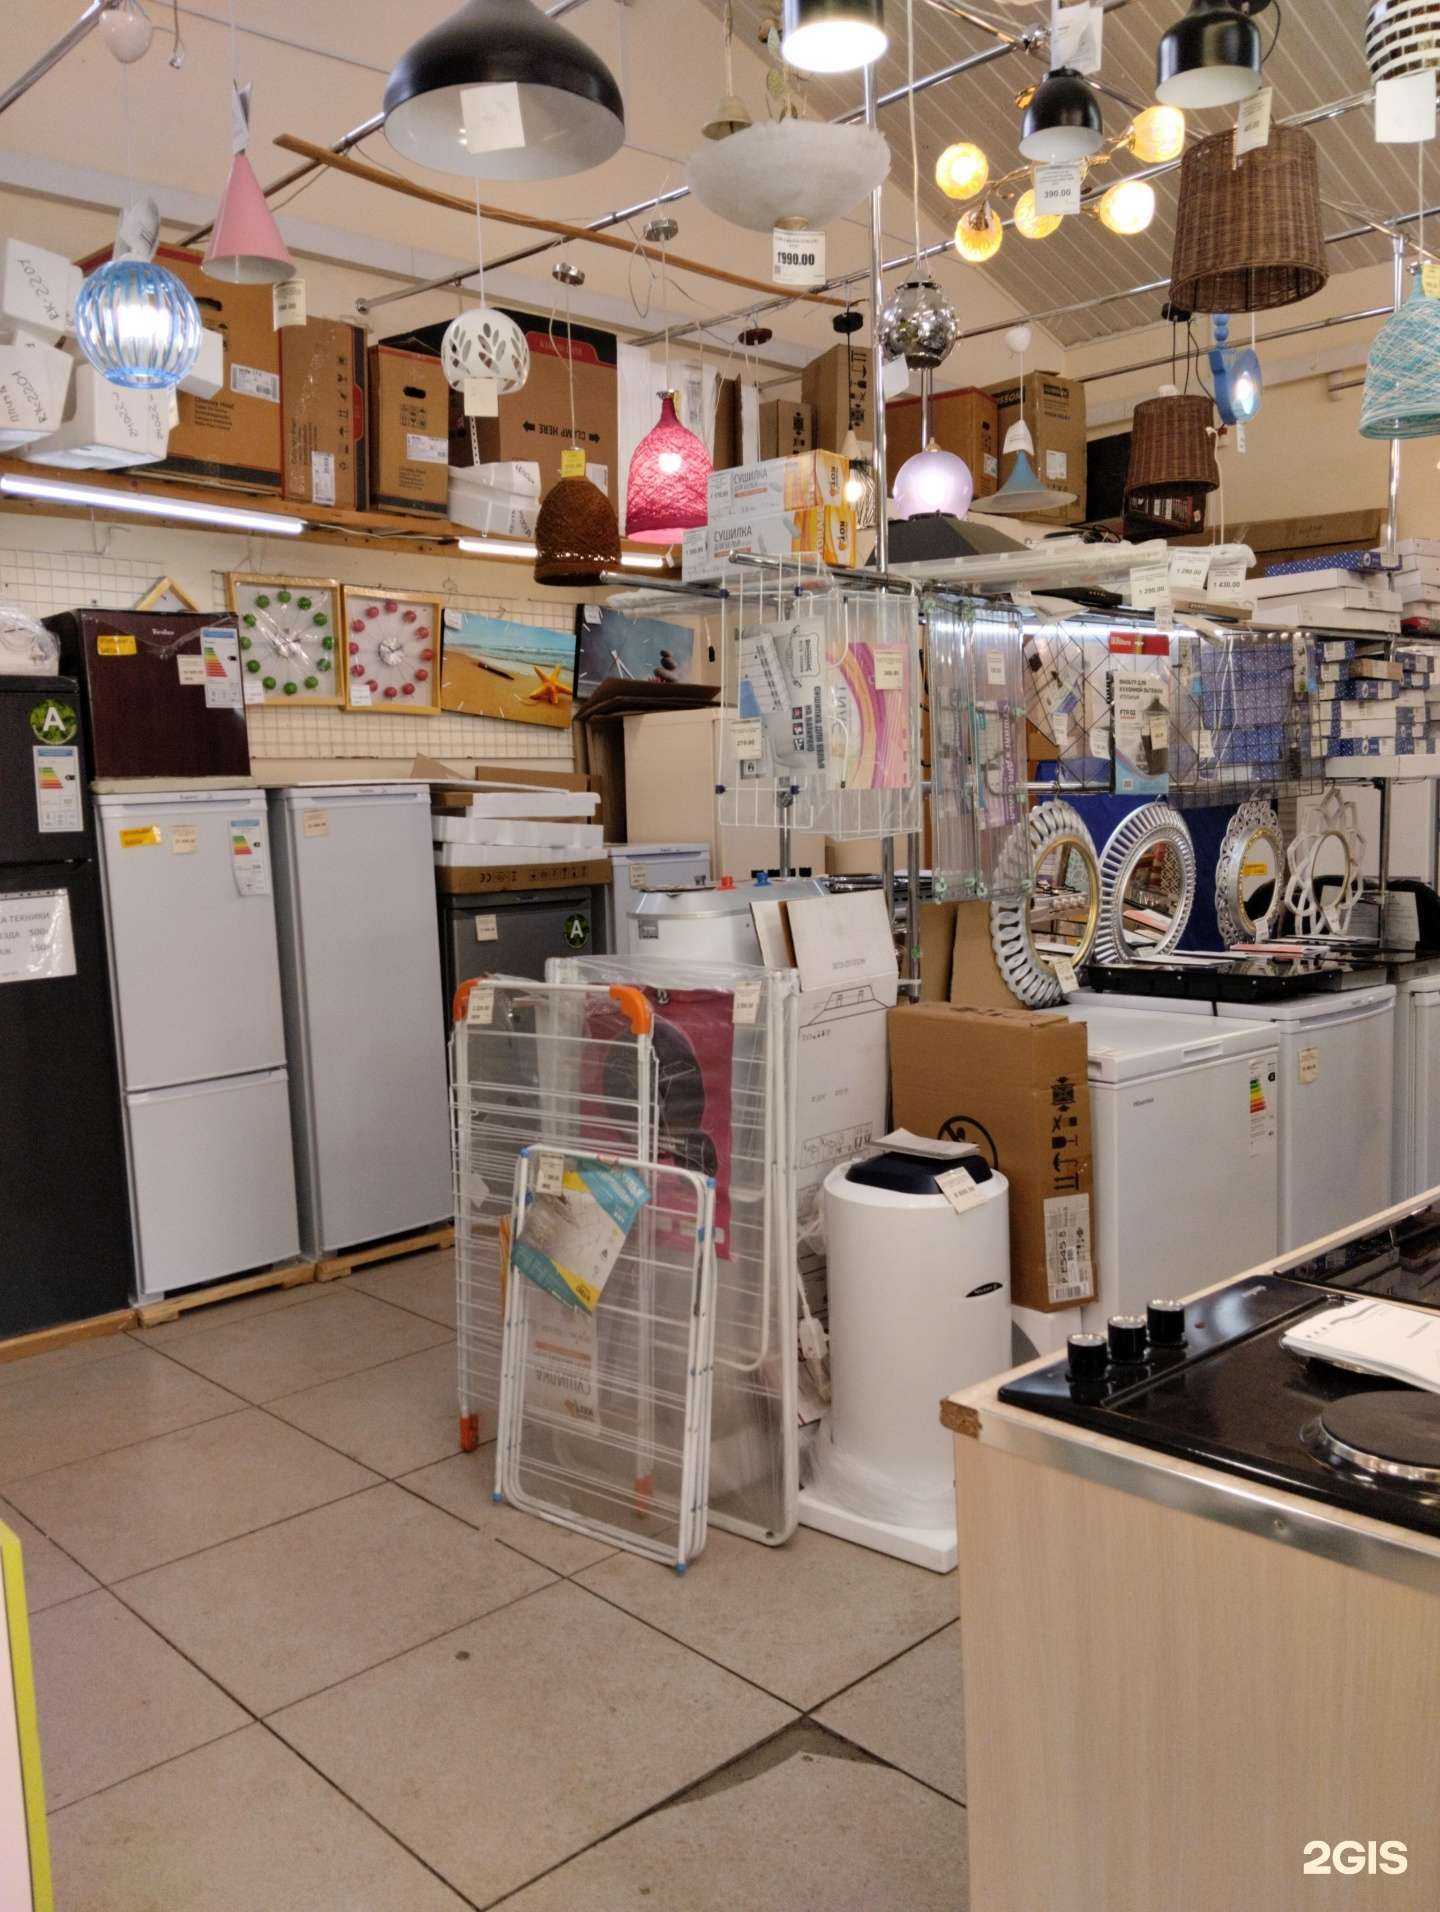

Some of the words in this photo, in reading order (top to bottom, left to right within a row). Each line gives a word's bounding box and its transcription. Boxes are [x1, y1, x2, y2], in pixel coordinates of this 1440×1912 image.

[734, 470, 768, 485] СУШИЛКА
[713, 525, 752, 543] СУШИЛКА
[43, 706, 66, 732] A
